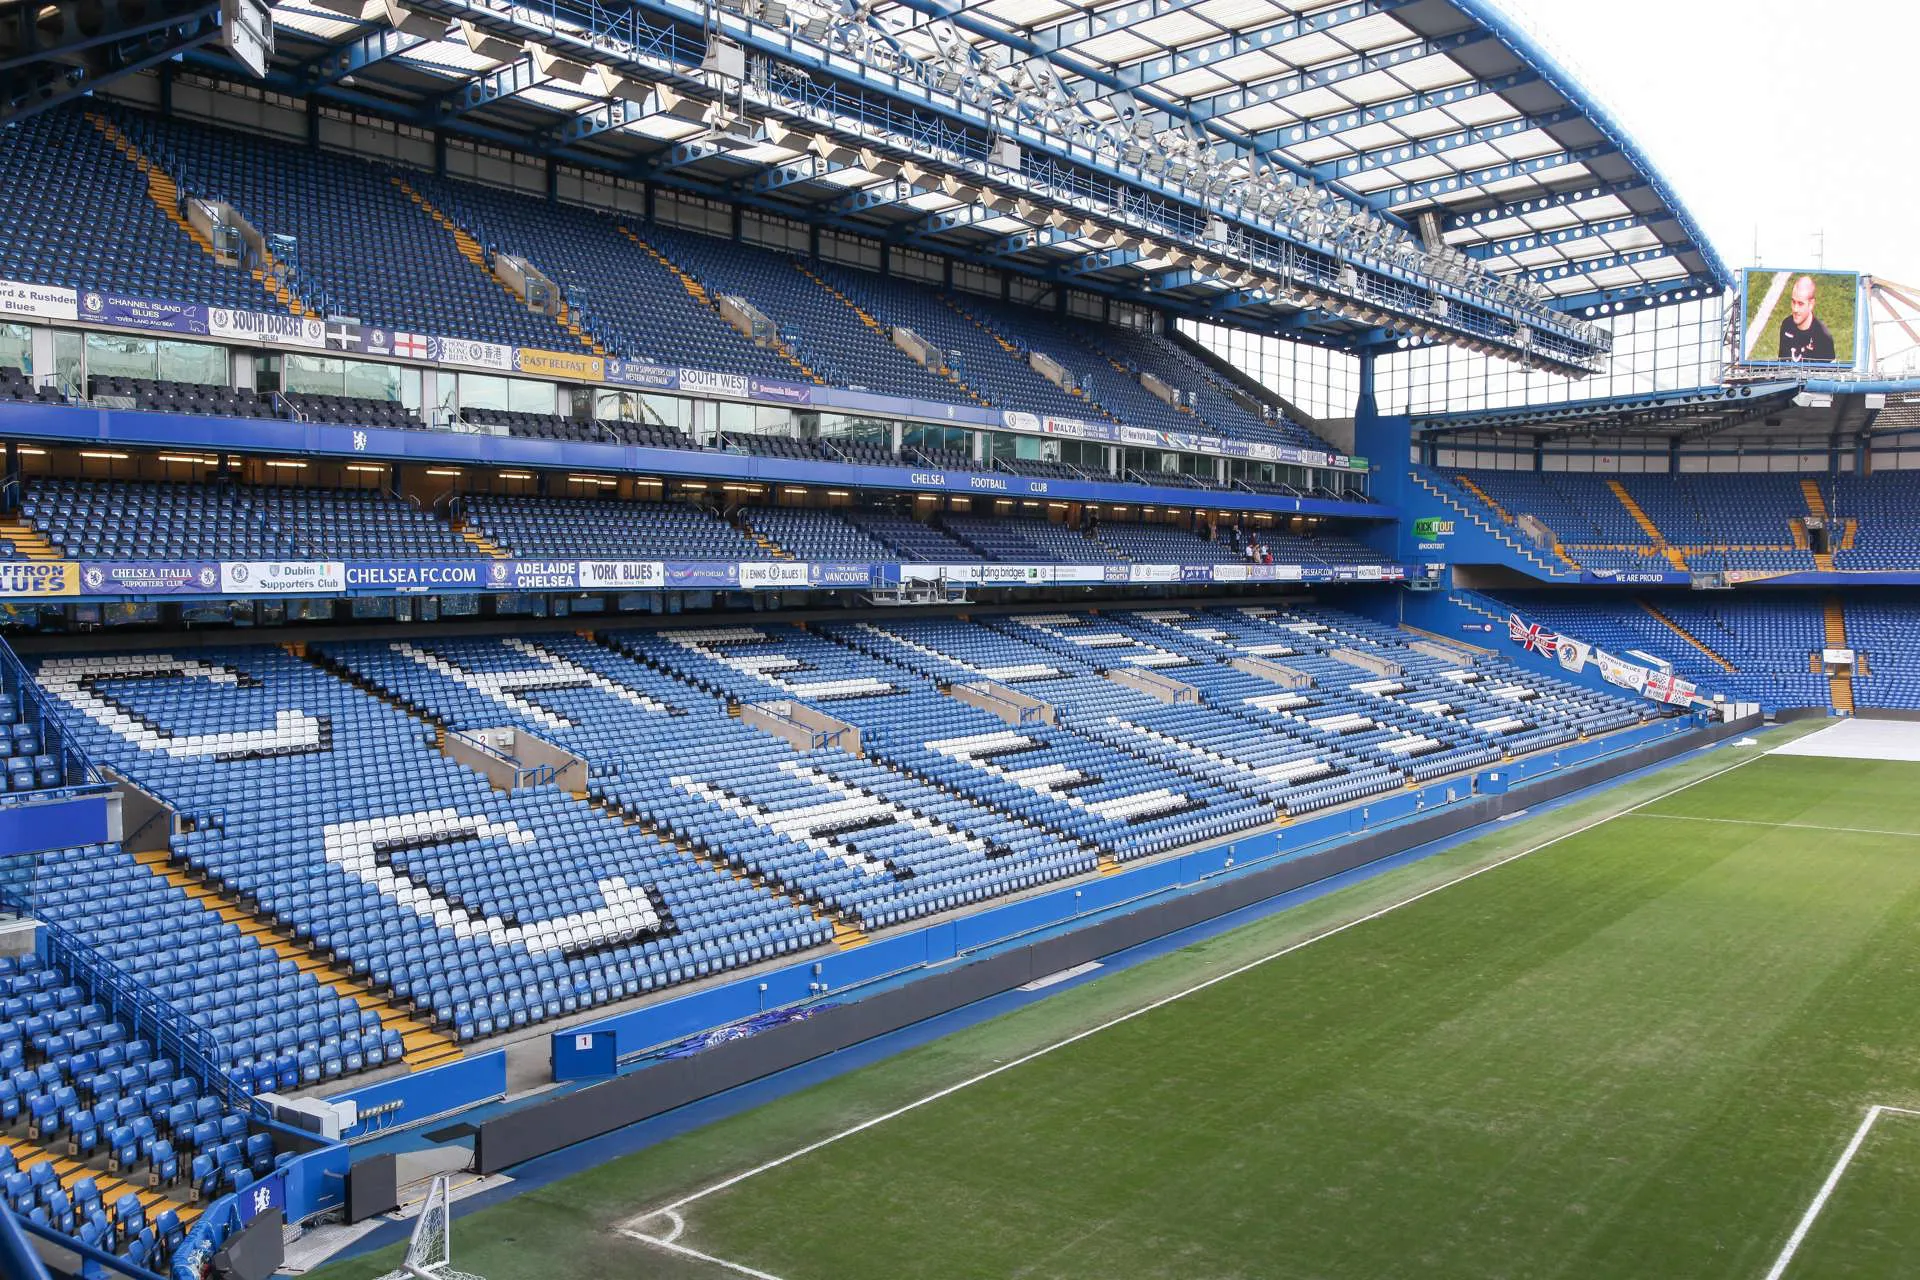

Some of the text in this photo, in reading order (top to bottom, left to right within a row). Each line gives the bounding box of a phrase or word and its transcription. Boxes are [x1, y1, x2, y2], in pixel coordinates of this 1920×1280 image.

[0, 289, 77, 305] rd & Rushden
[5, 300, 36, 312] Blues
[108, 298, 181, 313] CHANNEL ISLAND
[132, 308, 160, 318] BLUES
[232, 310, 304, 338] SOUTH DORSET
[258, 334, 279, 342] CHELSEA
[524, 356, 586, 372] EAST BELFAST
[680, 369, 717, 387] SOUTH
[720, 376, 747, 390] WEST
[1053, 423, 1077, 434] MALTA
[911, 473, 1048, 493] CHELSEA FOOTBALL CLUB
[1440, 521, 1454, 532] OUT
[0, 565, 64, 577] FFRON
[112, 568, 192, 578] CHELSEA ITALIA
[284, 566, 315, 577] Dublin
[515, 563, 576, 575] ADELAIDE
[591, 564, 652, 580] YORK BLUES
[749, 568, 799, 580] ENNIS BLUES
[971, 566, 1025, 580] buding bridges
[518, 575, 574, 588] CHELSEA
[824, 572, 869, 582] VANCOUVER
[1616, 574, 1663, 582] WE ARE PROUD
[260, 579, 338, 590] Supporters Club
[479, 735, 486, 746] 2
[581, 1037, 588, 1046] 1
